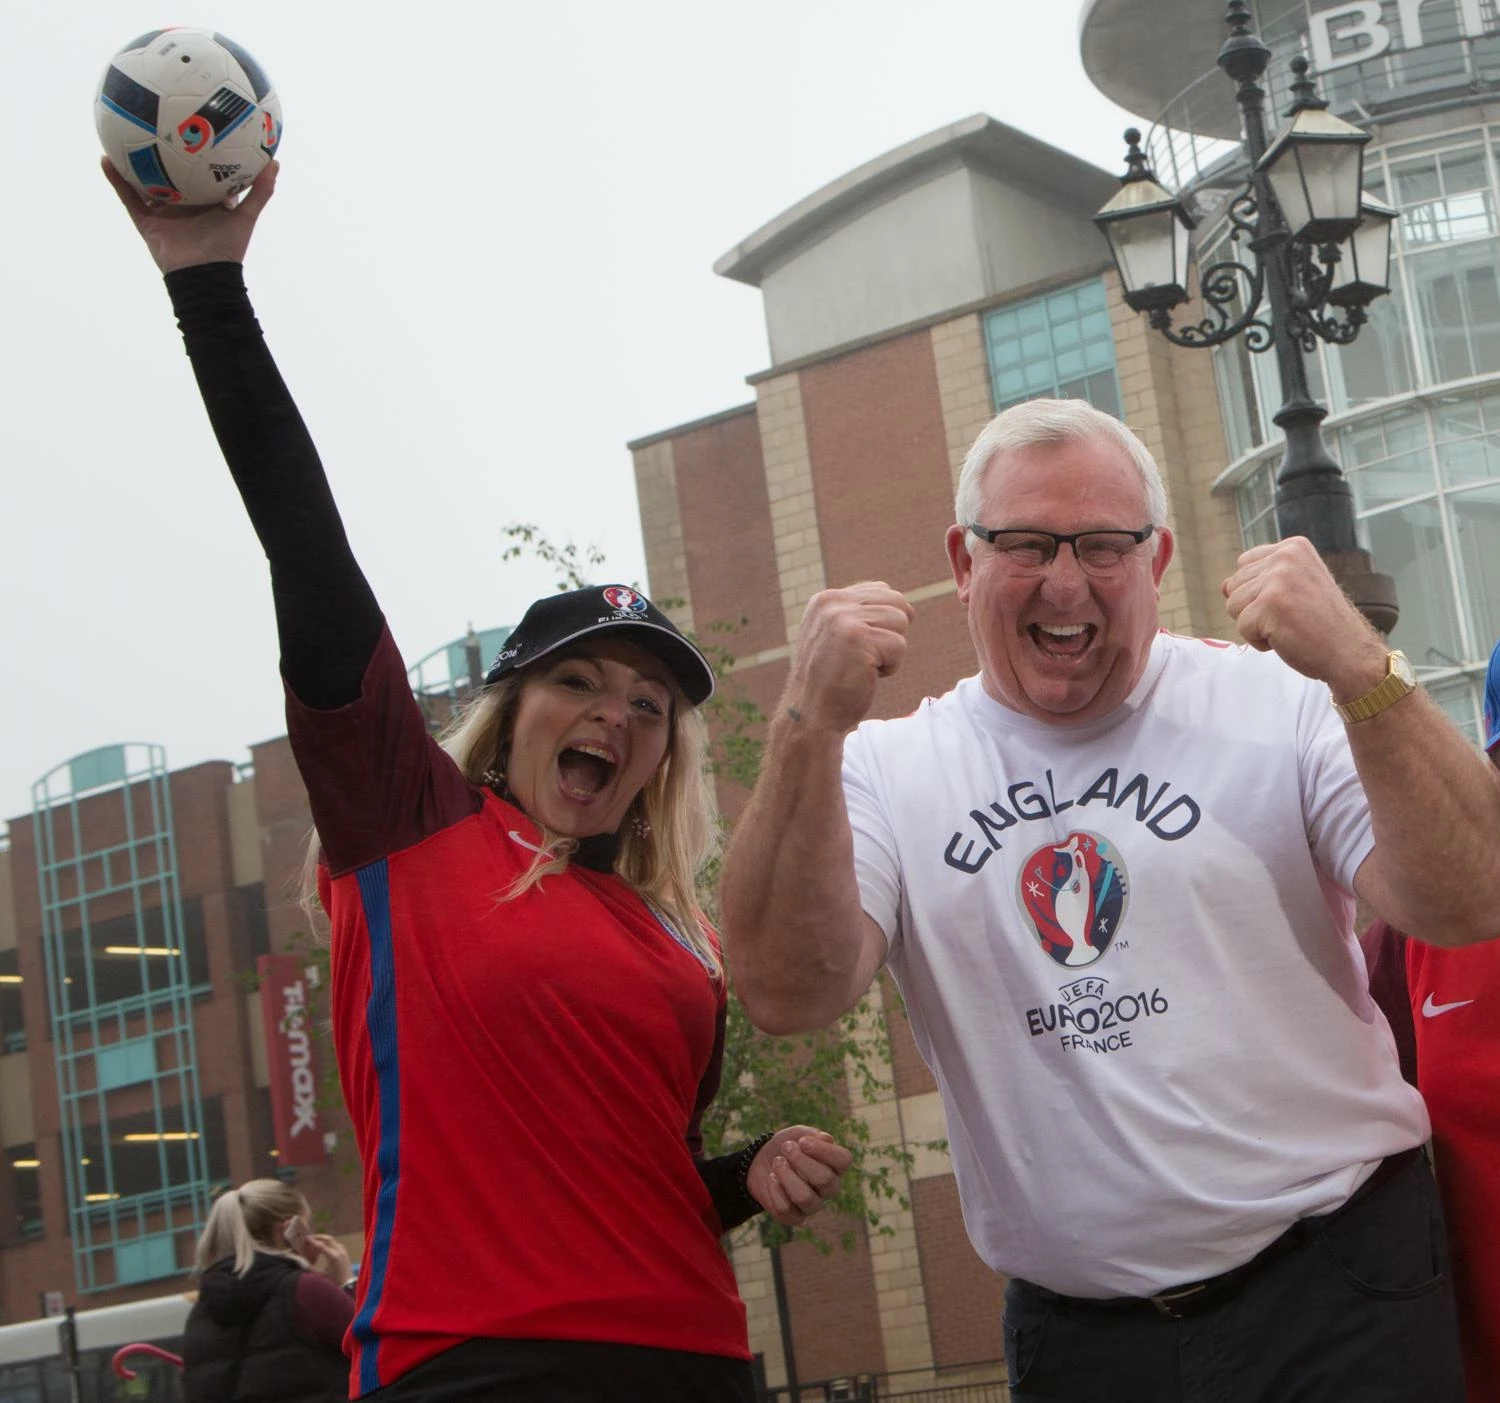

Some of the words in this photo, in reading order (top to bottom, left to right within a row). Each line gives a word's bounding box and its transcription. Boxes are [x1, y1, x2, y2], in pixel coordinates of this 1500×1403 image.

[944, 768, 1202, 875] ENGLAND
[1114, 940, 1130, 952] TM
[1061, 981, 1104, 1002] UEFA
[1026, 988, 1169, 1036] EURO2016
[1060, 1031, 1133, 1053] FRANCE
